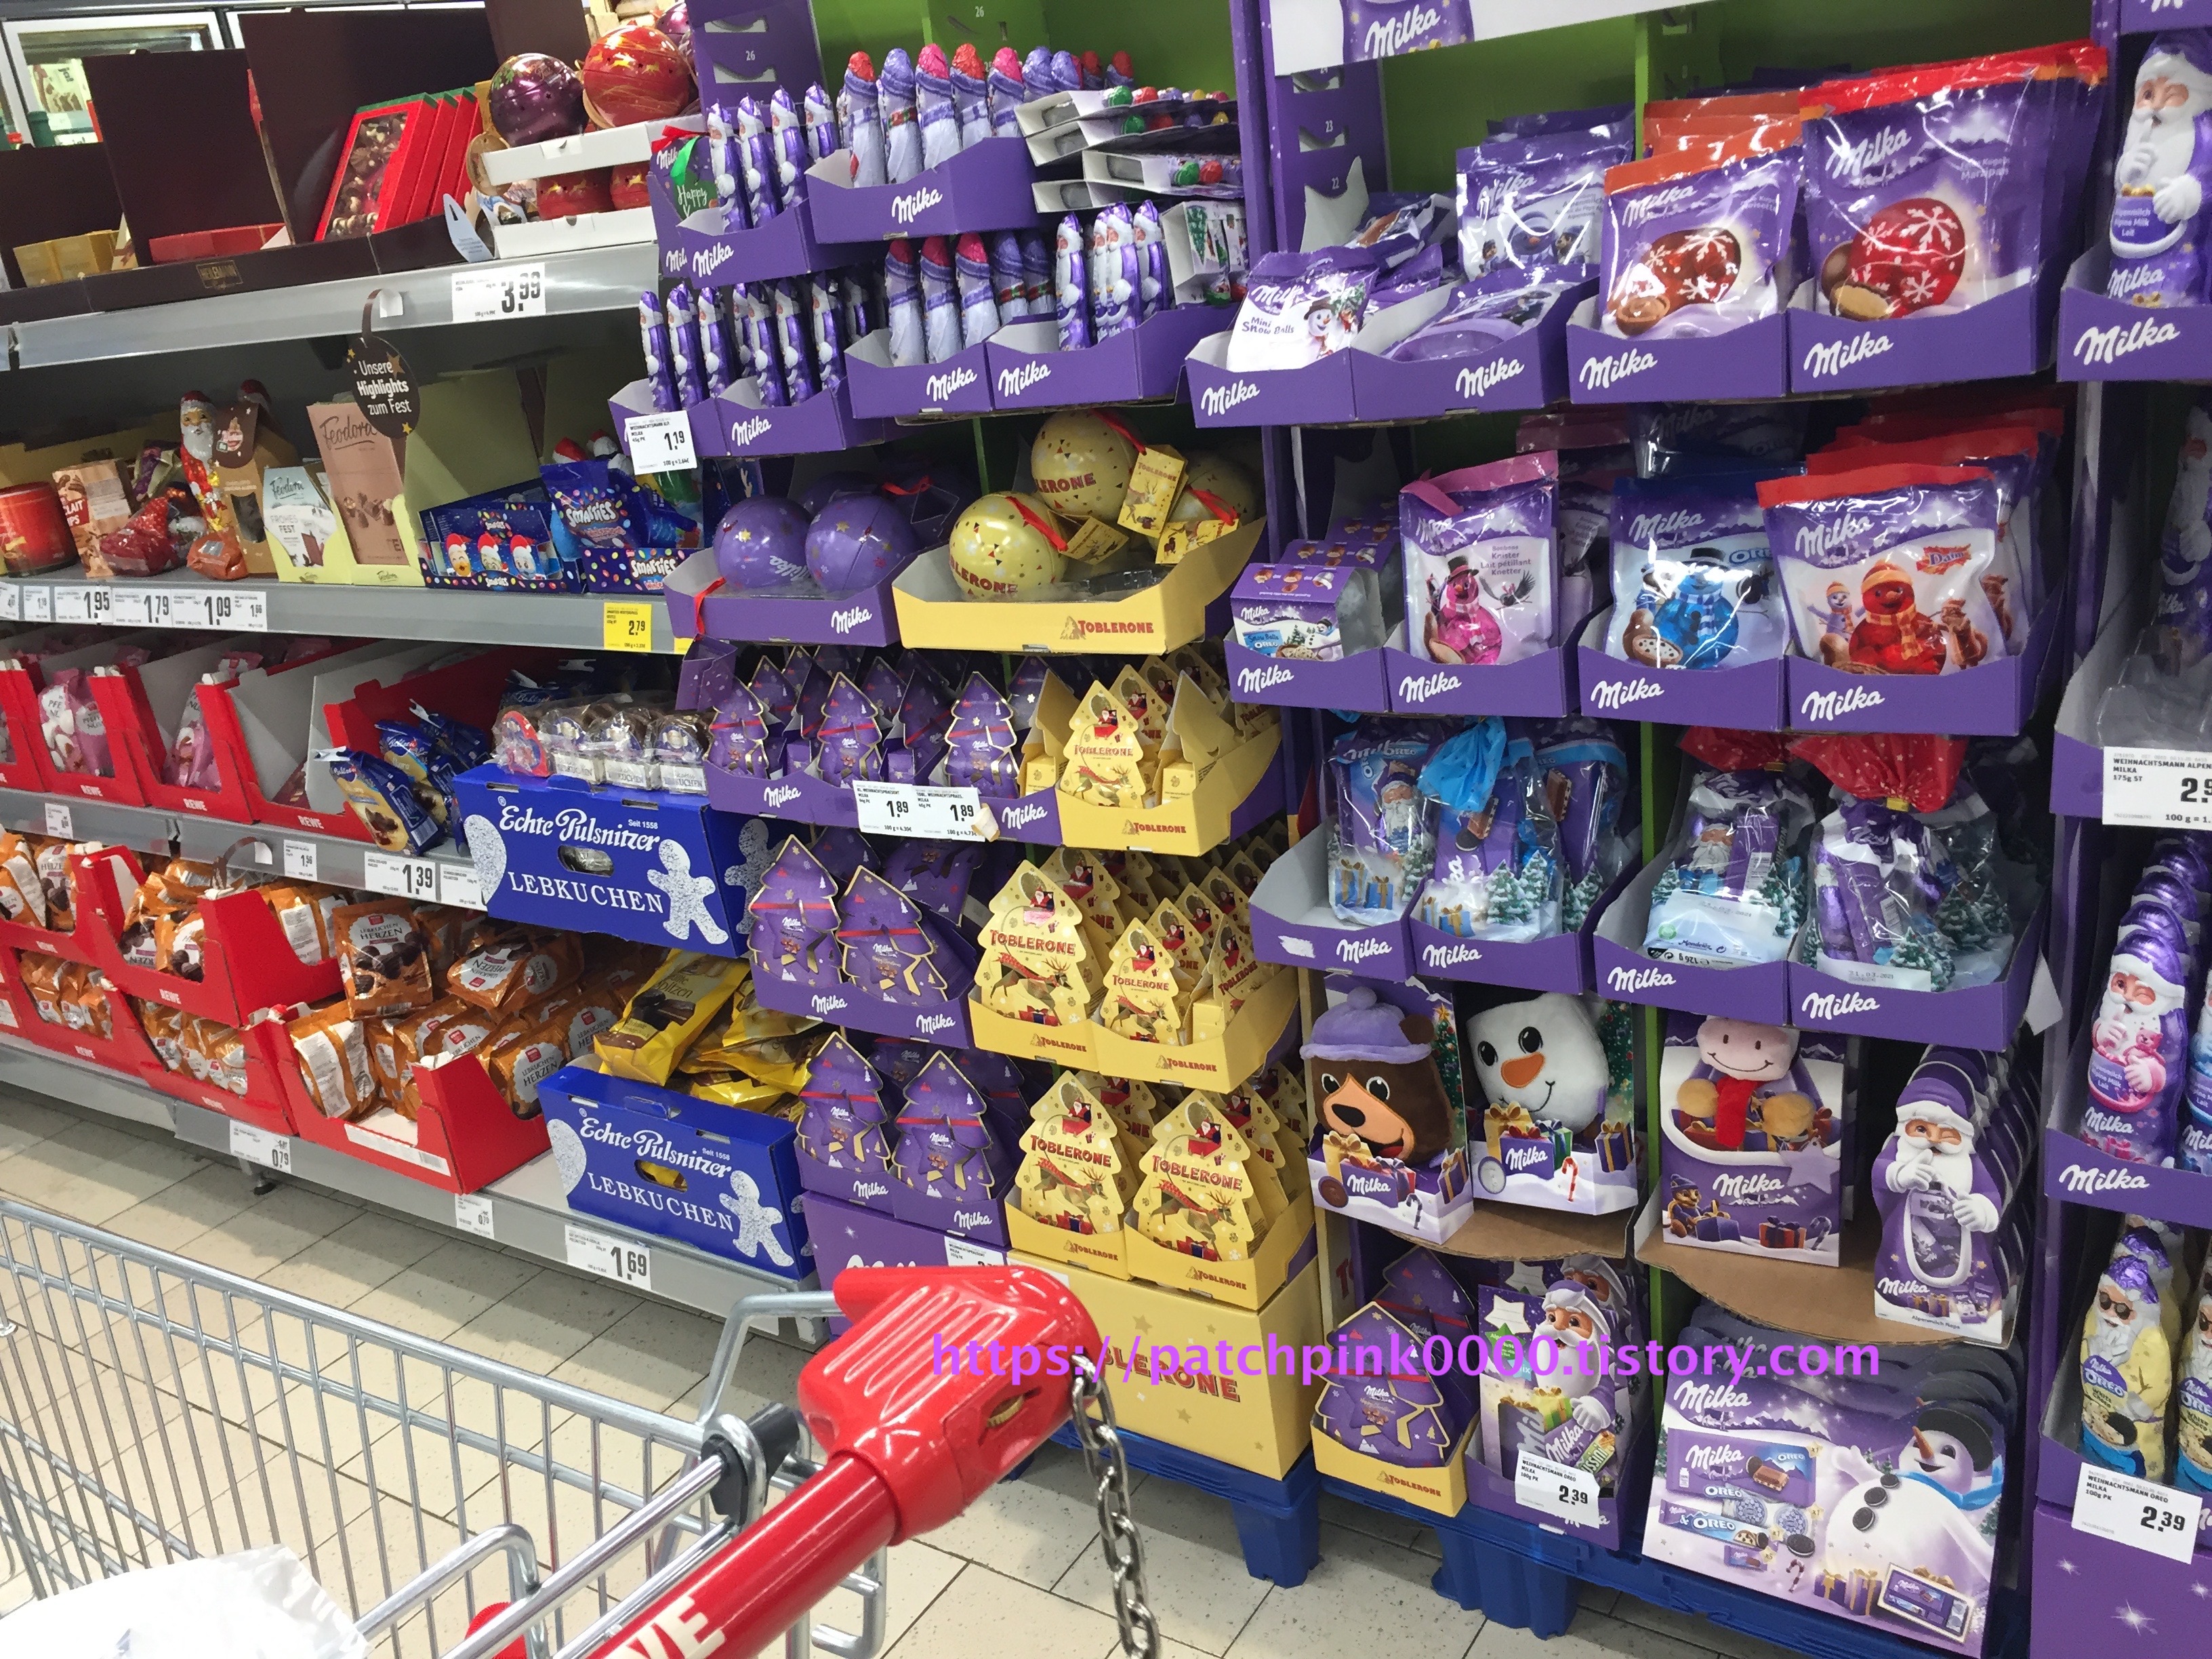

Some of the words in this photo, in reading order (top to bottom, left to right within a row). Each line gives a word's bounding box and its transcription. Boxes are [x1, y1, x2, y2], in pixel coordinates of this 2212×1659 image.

[975, 5, 985, 18] 26
[1364, 3, 1441, 59] Milka
[1325, 120, 1334, 133] 23
[1825, 125, 1912, 178] Milka
[1330, 177, 1340, 190] 22
[677, 184, 708, 208] Happy
[891, 186, 944, 225] Milka
[1622, 185, 1700, 226] Milka
[693, 241, 735, 277] Milka
[501, 271, 541, 313] 3.99
[2107, 264, 2166, 299] Milka
[1242, 321, 1272, 335] Snow
[1250, 316, 1272, 329] Mini
[2074, 316, 2182, 366] Milka
[1803, 331, 1896, 377] Milka
[358, 360, 393, 375] Unsere
[998, 361, 1052, 397] Milka
[1455, 356, 1526, 398] Milka
[1579, 348, 1658, 390] Milka
[356, 377, 409, 398] Highlights
[926, 367, 979, 403] Milka
[367, 403, 389, 416] zum
[390, 398, 413, 415] Fest
[1200, 380, 1261, 416] Milka
[319, 415, 377, 451] Feodora
[664, 430, 685, 451] 1.19
[732, 415, 773, 447] Milka
[1137, 461, 1176, 483] TOBLERONE
[565, 501, 617, 527] SMARTIES
[1629, 509, 1706, 541] Milka
[278, 524, 296, 534] FEST
[1796, 512, 1876, 558] Milka
[1928, 548, 1966, 567] Daim
[83, 591, 110, 619] 1.95
[143, 594, 170, 623] 1.79
[203, 596, 232, 626] 1.09
[1240, 605, 1271, 621] Milka
[628, 620, 646, 636] 2.79
[831, 606, 873, 634] Milka
[1077, 620, 1154, 634] TOBLERONE
[1237, 663, 1294, 693] Milka
[1399, 671, 1462, 703] Milka
[1590, 677, 1666, 709] Milka
[1801, 684, 1886, 722] Milka
[1073, 744, 1134, 758] TOBLERONE
[2113, 758, 2185, 768] WEIHNACHTSMANN
[764, 783, 802, 808] Milka
[2180, 777, 2212, 803] 2.9
[182, 798, 207, 811] REWE
[886, 800, 909, 818] 1.89
[949, 804, 975, 821] 1.89
[1002, 803, 1048, 830] Milka
[297, 815, 325, 830] REWE
[499, 805, 553, 838] Echte
[555, 808, 661, 853] Pulsnitzer
[628, 818, 642, 829] Seit
[642, 819, 659, 830] 1558
[1133, 822, 1187, 834] TOBLERONE
[402, 863, 433, 895] 1.39
[508, 871, 664, 914] LEBKUCHEN
[781, 916, 802, 926] Milka
[359, 927, 403, 941] HERZEN
[989, 928, 1076, 957] TOBLERONE
[872, 943, 894, 953] Milka
[1336, 938, 1392, 964] Milka
[1422, 944, 1482, 968] Milka
[1112, 974, 1170, 992] TOBLERONE
[1607, 966, 1677, 994] Milka
[811, 994, 848, 1015] Milka
[1801, 993, 1881, 1021] Milka
[916, 1014, 956, 1035] Milka
[1041, 1037, 1087, 1053] TOBLERONE
[523, 1061, 559, 1088] HERZEN
[1167, 1059, 1217, 1073] TOBLERONE
[830, 1105, 849, 1117] Milka
[2085, 1106, 2135, 1132] Milka
[579, 1118, 632, 1150] Echte
[633, 1129, 733, 1179] Pulsnitzer
[929, 1132, 949, 1143] Milka
[701, 1147, 714, 1158] Seit
[715, 1151, 731, 1162] 1558
[1029, 1134, 1112, 1168] TOBLERONE
[1505, 1146, 1549, 1171] Milka
[1152, 1154, 1243, 1193] TOBLERONE
[1347, 1174, 1391, 1197] Milka
[1713, 1173, 1785, 1197] Milka
[2058, 1164, 2150, 1195] Milka
[853, 1180, 889, 1200] Milka
[586, 1172, 735, 1233] LEBKUCHEN
[954, 1210, 993, 1231] Milka
[610, 1246, 647, 1281] 1.69
[1073, 1243, 1119, 1261] TOBLERONE
[1197, 1269, 1248, 1291] TOBLERONE
[1877, 1277, 1930, 1296] Milka
[1364, 1385, 1390, 1397] Milka
[2084, 1367, 2125, 1398] OREO
[1673, 1380, 1752, 1410] Milka
[1546, 1422, 1583, 1464] Milka
[1685, 1443, 1745, 1469] Milka
[1777, 1453, 1805, 1461] OREO
[1520, 1465, 1536, 1475] MILKA
[1388, 1474, 1442, 1497] TOBLERONE
[1559, 1484, 1589, 1506] 2.39
[1704, 1486, 1743, 1498] OREO
[2085, 1488, 2102, 1499] 100g
[2086, 1481, 2108, 1492] MILKA
[2087, 1475, 2149, 1497] WEIHNACHTSMANN
[2150, 1493, 2169, 1503] OREO
[1679, 1515, 1689, 1525] &
[1692, 1517, 1737, 1531] OREO
[2140, 1505, 2186, 1532] 2.39
